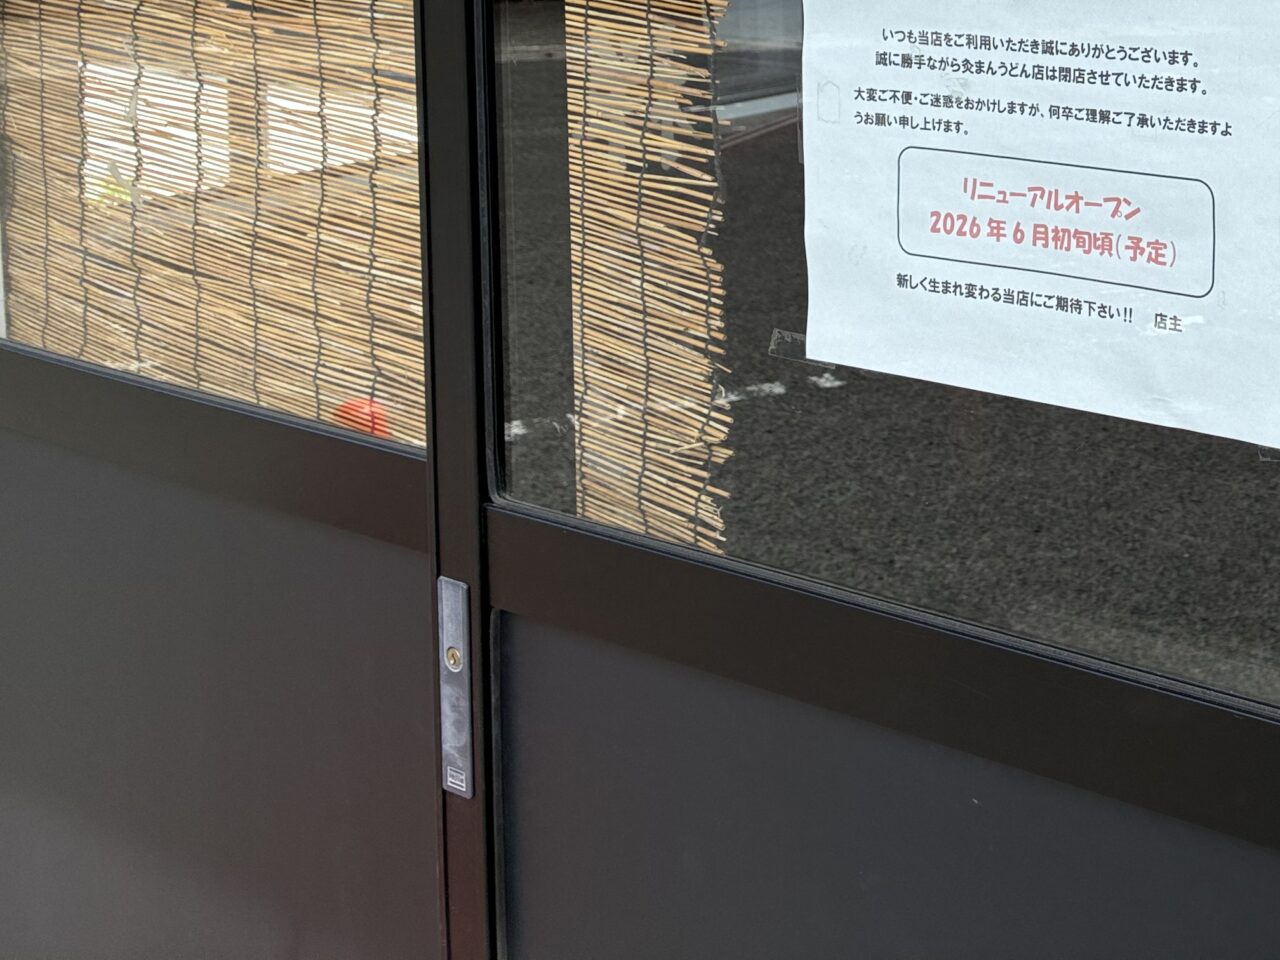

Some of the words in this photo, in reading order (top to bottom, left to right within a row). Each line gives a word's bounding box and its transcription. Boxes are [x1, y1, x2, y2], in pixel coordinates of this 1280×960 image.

[882, 28, 1199, 68] いつも当店をご利用いただき誠にありがとうございます。
[875, 50, 1207, 95] 誠に勝手ながら灸まんうどん店は閉店させていただきます。
[853, 111, 969, 136] うお願い申し上げます。
[962, 177, 1141, 221] リニューアルオープン
[1154, 312, 1183, 332] 店主
